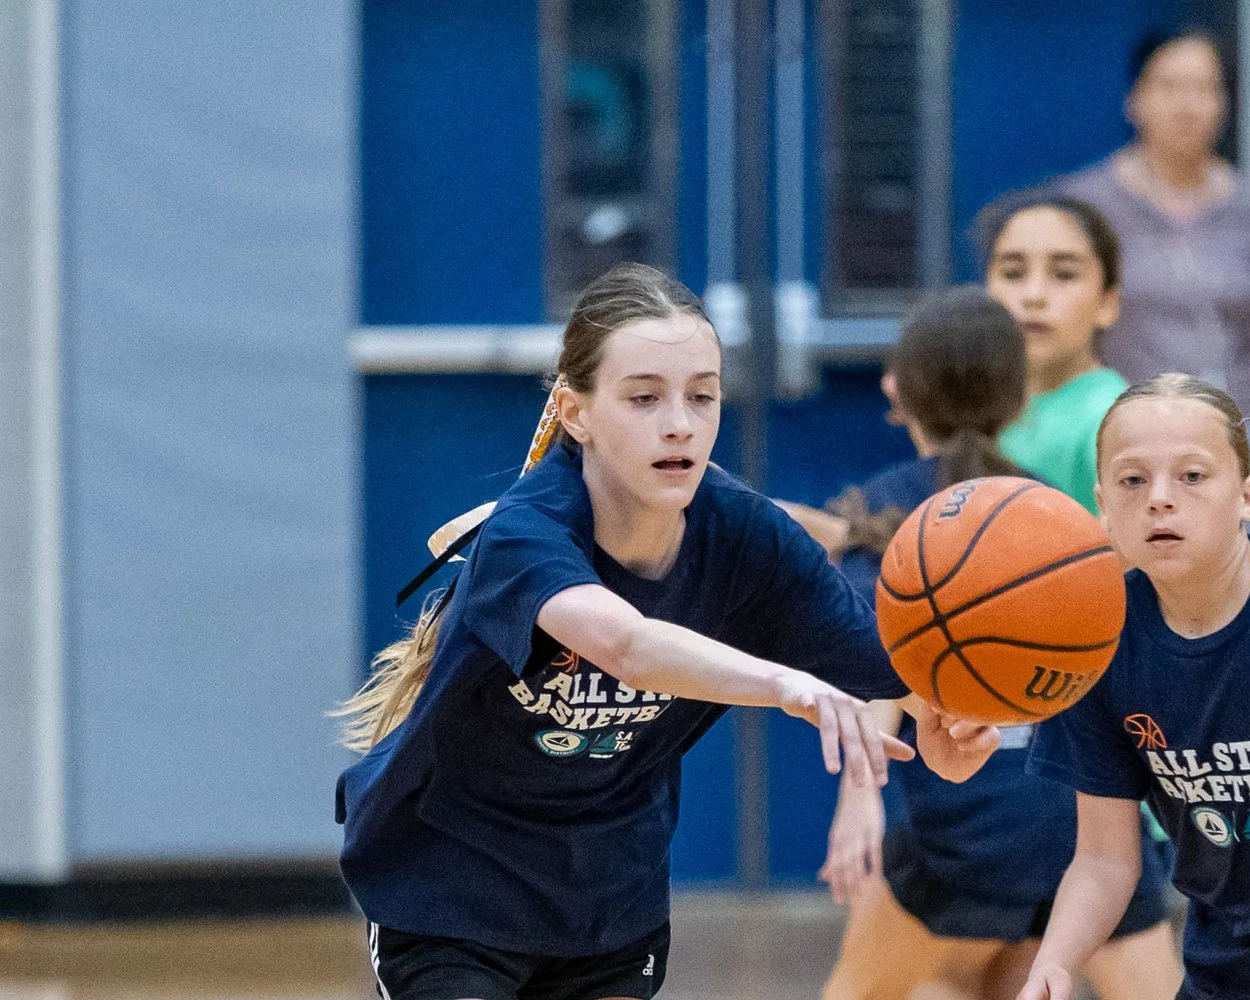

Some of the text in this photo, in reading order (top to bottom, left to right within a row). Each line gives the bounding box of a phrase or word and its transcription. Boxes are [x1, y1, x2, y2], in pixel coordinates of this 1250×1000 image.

[543, 672, 607, 704] ALL
[508, 680, 670, 730] BASKETB
[1146, 749, 1212, 777] ALL
